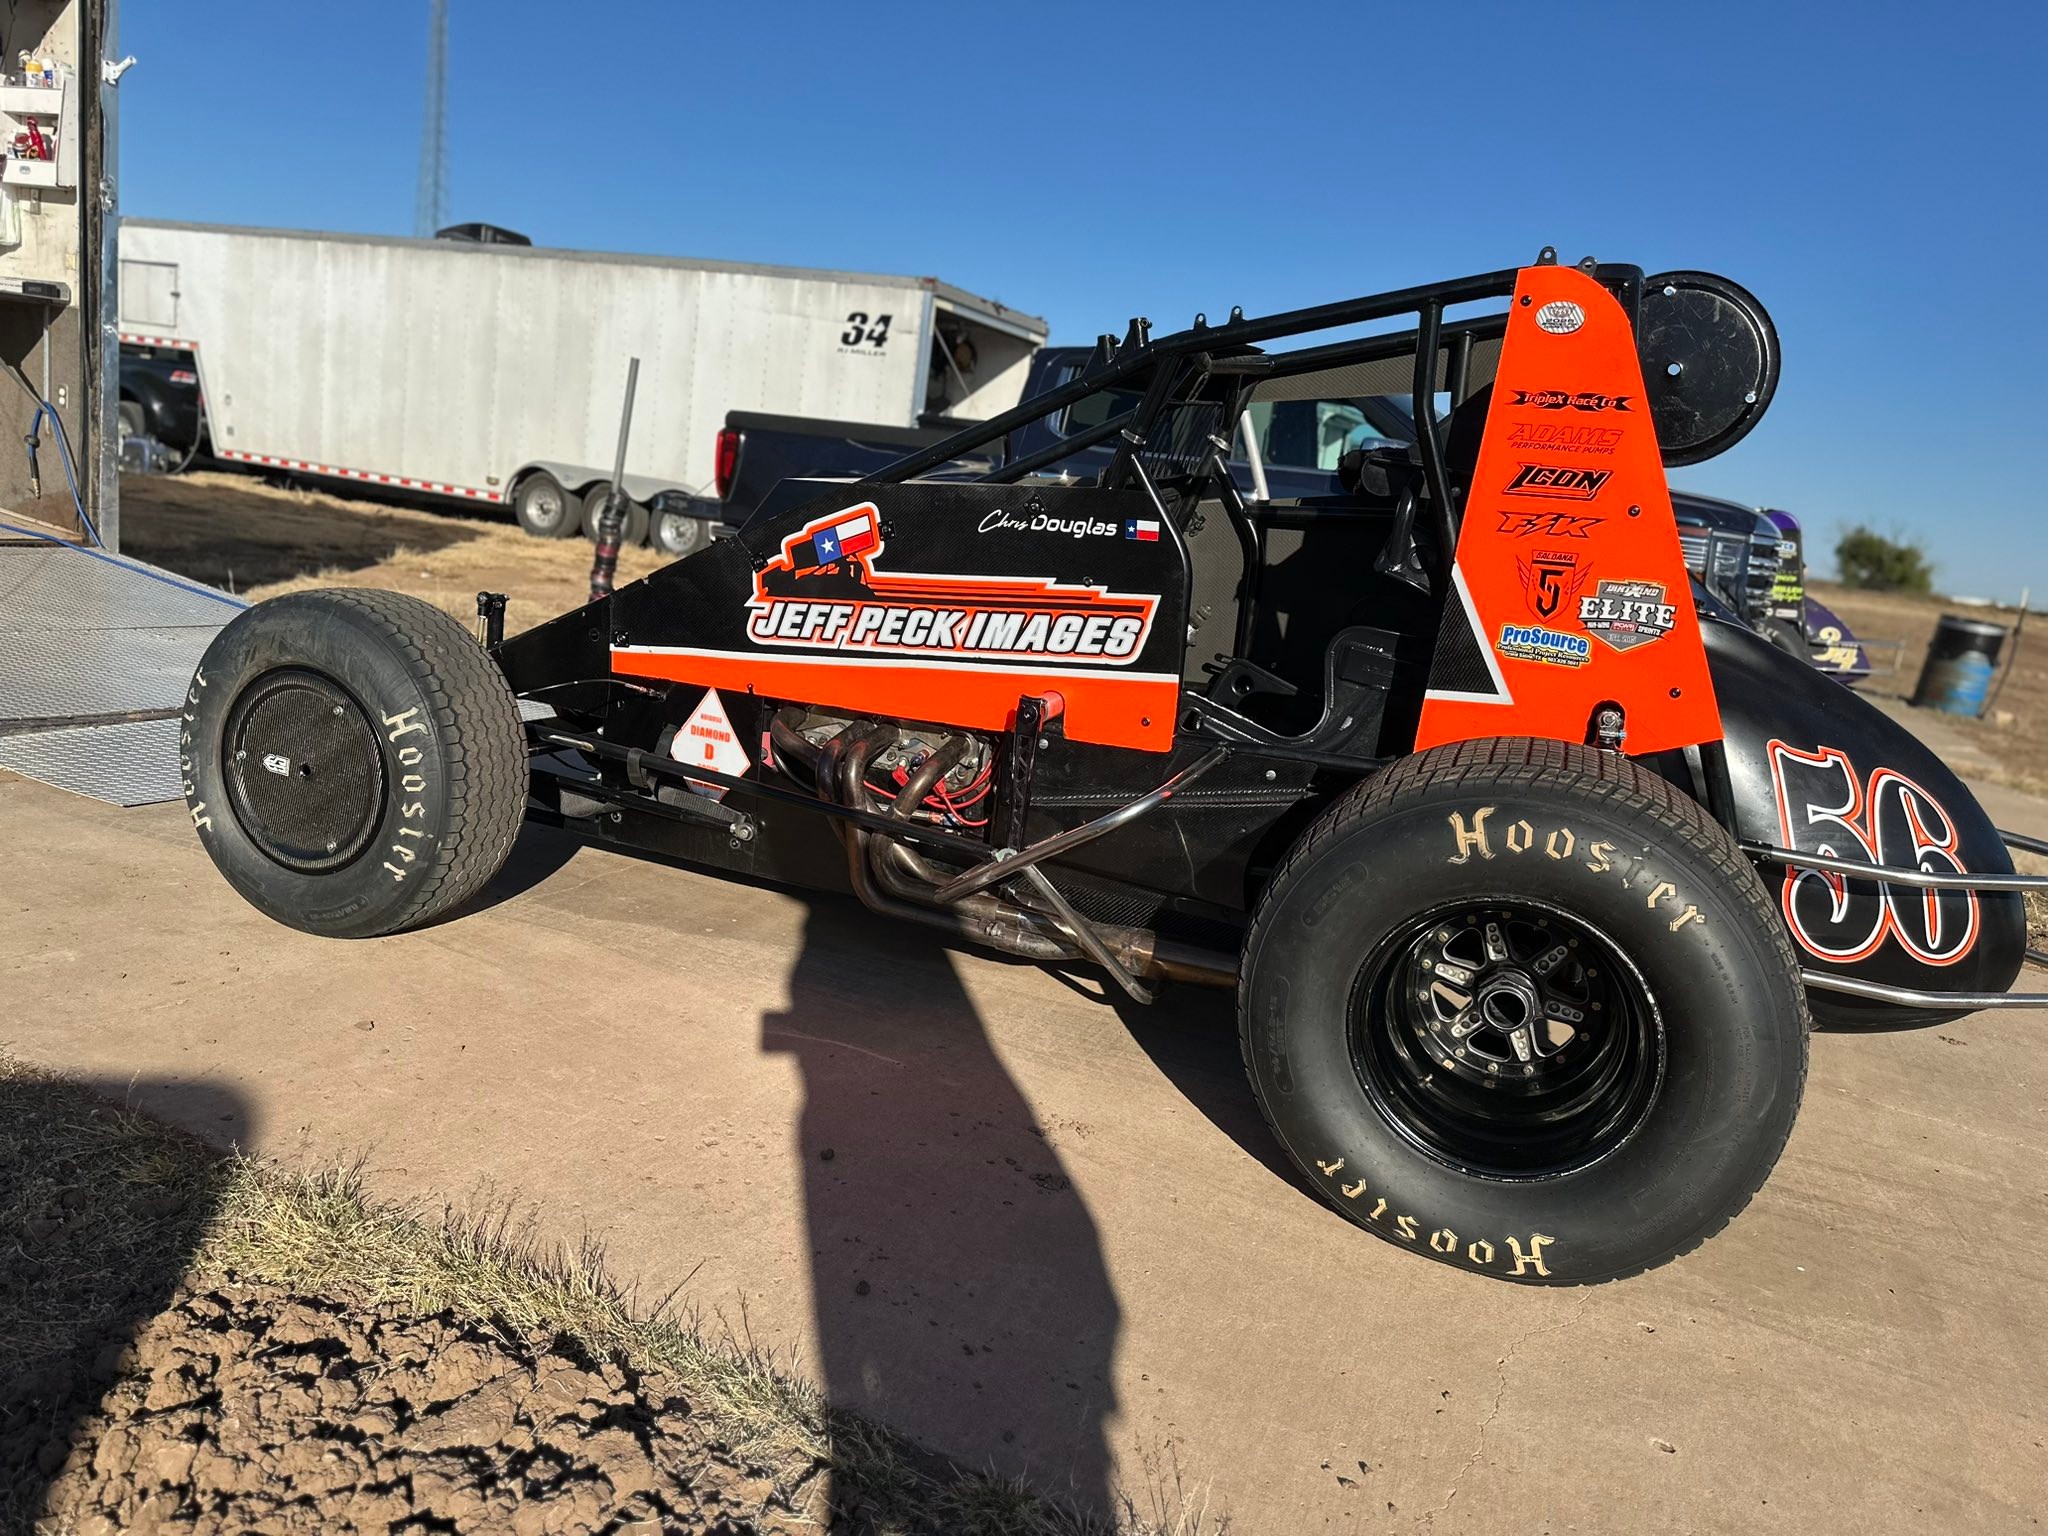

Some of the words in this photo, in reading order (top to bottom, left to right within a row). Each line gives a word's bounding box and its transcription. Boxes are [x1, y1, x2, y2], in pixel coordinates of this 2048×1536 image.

[841, 312, 892, 348] 34
[1523, 393, 1565, 405] TripleX
[1566, 395, 1598, 406] Race
[1600, 397, 1617, 407] Co
[1506, 422, 1624, 447] ADAMS
[1510, 441, 1581, 453] PERFORMANCE
[1582, 446, 1615, 455] PUMPS
[1504, 462, 1614, 497] ICON
[977, 509, 1029, 533] Chris
[1030, 514, 1118, 539] Douglas
[1536, 552, 1573, 562] SALDANA
[1579, 597, 1676, 629] ELITE
[754, 602, 852, 640] JEFF
[852, 606, 967, 648] PECK
[966, 612, 1143, 657] IMAGES
[1502, 626, 1588, 655] ProSource
[1637, 625, 1661, 636] SPRINTS
[1534, 648, 1557, 658] Project
[690, 724, 731, 743] DIAMOND
[181, 667, 213, 832] Hoosier
[703, 742, 715, 761] D
[381, 706, 434, 882] Hoosier
[1766, 738, 1980, 967] 56
[1446, 806, 1706, 932] Hoosier
[1317, 1156, 1555, 1276] Hoosier
